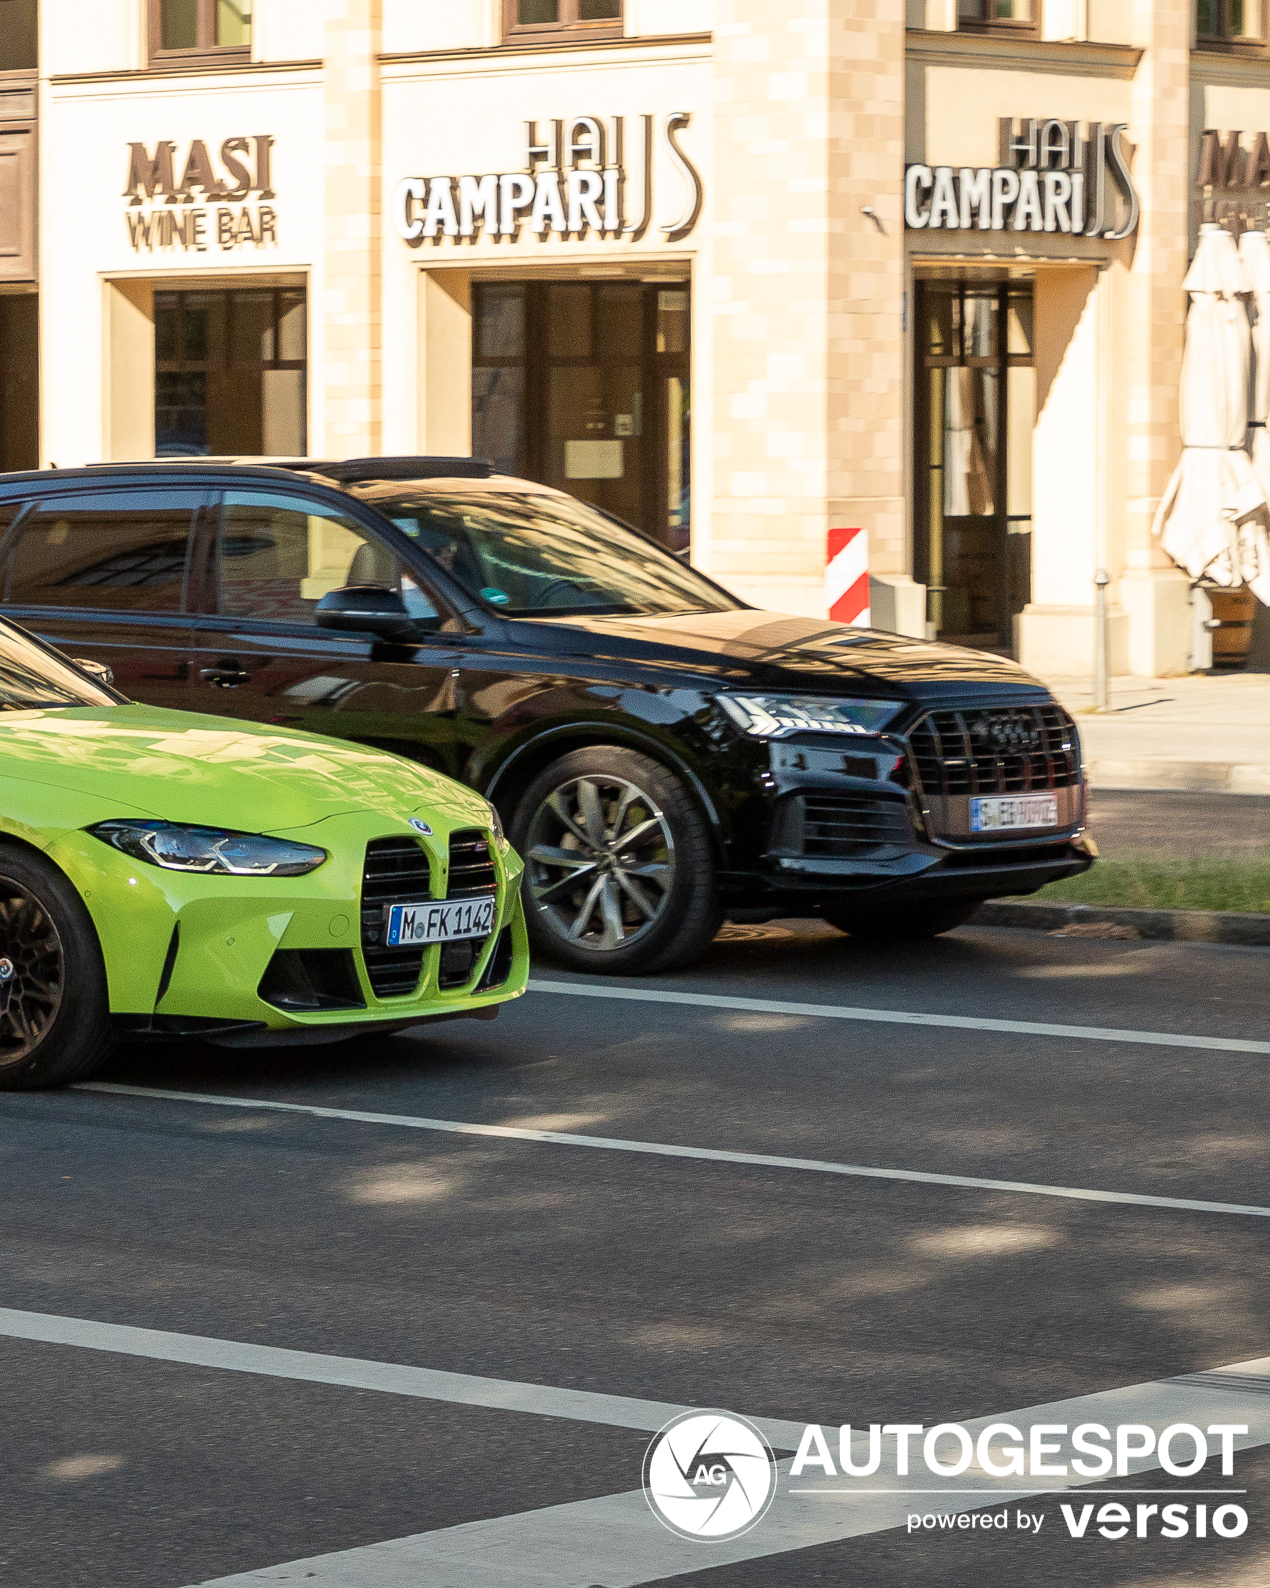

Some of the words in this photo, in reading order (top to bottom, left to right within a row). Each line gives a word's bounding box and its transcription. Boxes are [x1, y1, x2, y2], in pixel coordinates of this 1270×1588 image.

[122, 135, 276, 200] MASI
[904, 163, 1085, 232] CAMPARI
[127, 208, 207, 250] WINE
[216, 205, 277, 247] BAR
[395, 169, 624, 242] CAMPARI
[401, 911, 416, 939] M
[426, 907, 451, 938] FK
[453, 903, 491, 935] 1142
